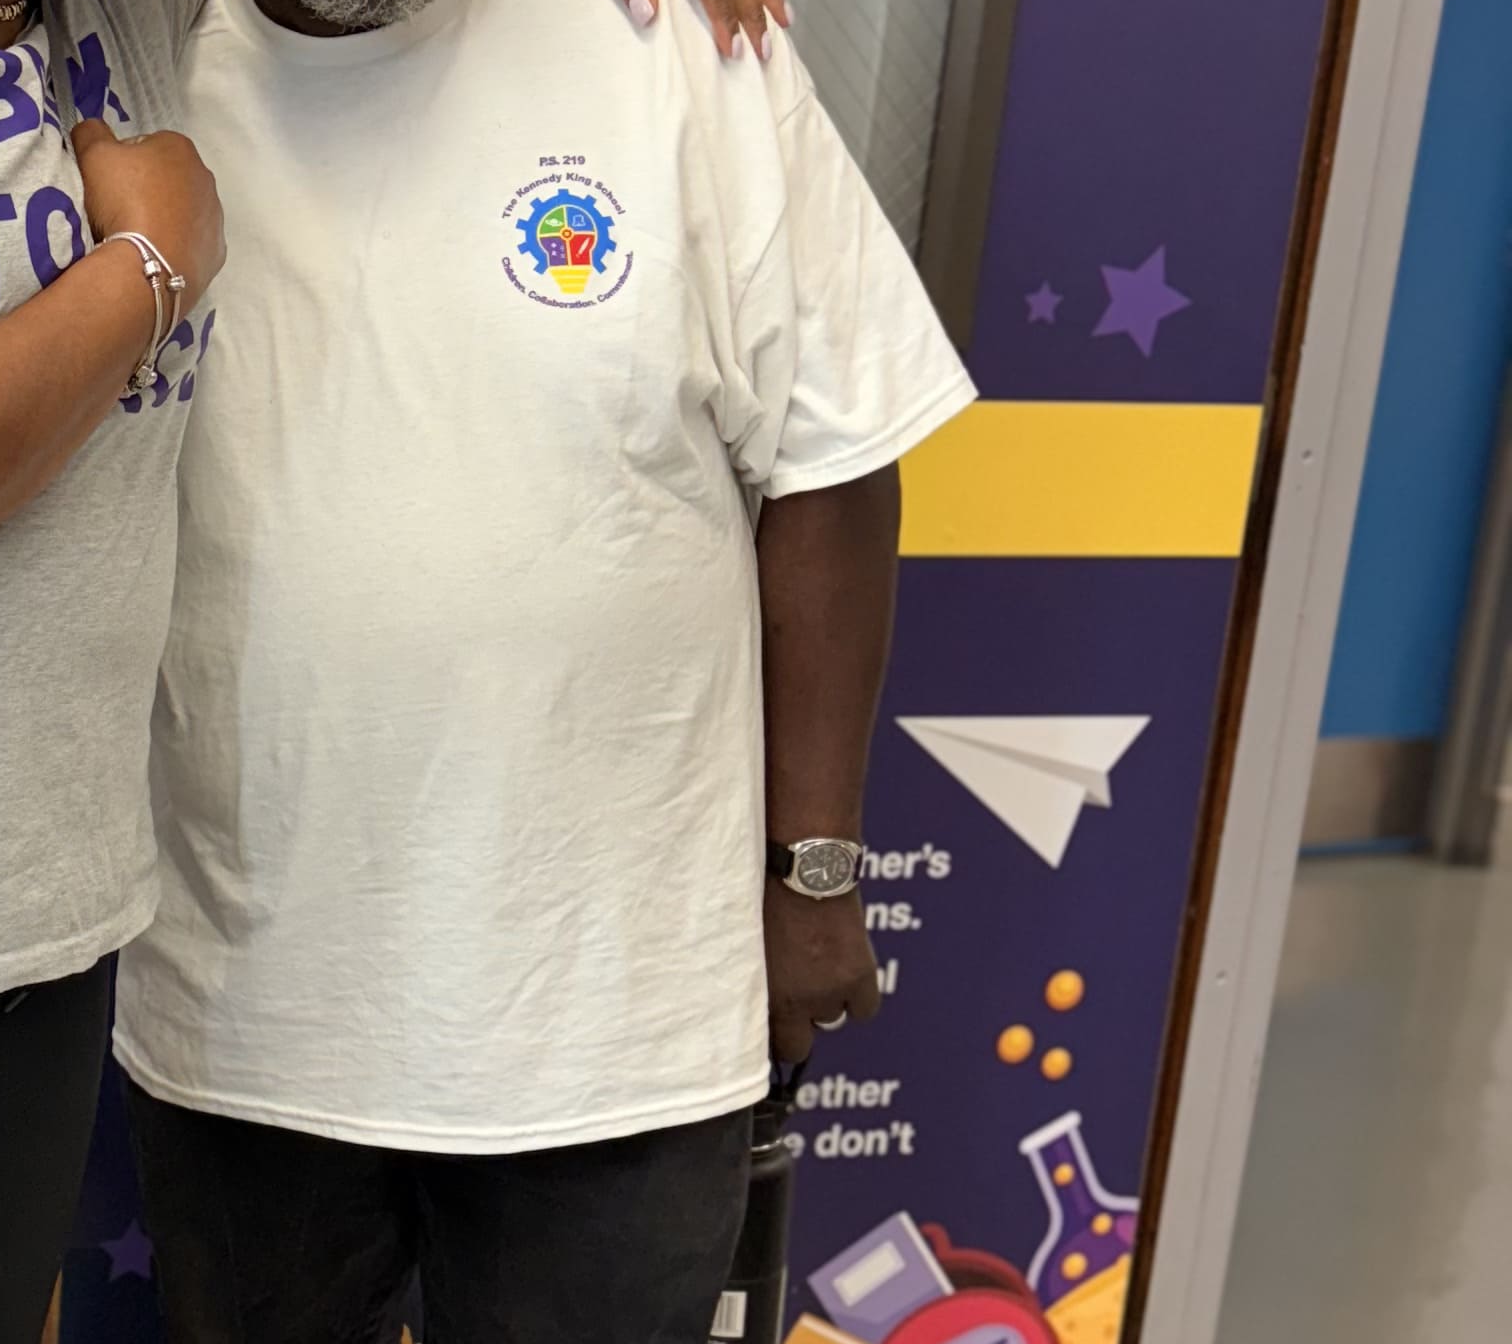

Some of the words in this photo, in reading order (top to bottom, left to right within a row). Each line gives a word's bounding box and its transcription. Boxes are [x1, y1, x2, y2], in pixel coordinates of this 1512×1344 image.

[562, 155, 587, 166] 219
[501, 198, 518, 219] The
[515, 173, 563, 199] Kennedy
[565, 172, 593, 187] King
[594, 181, 627, 216] School
[787, 1073, 901, 1112] ether
[813, 1120, 916, 1158] don't
